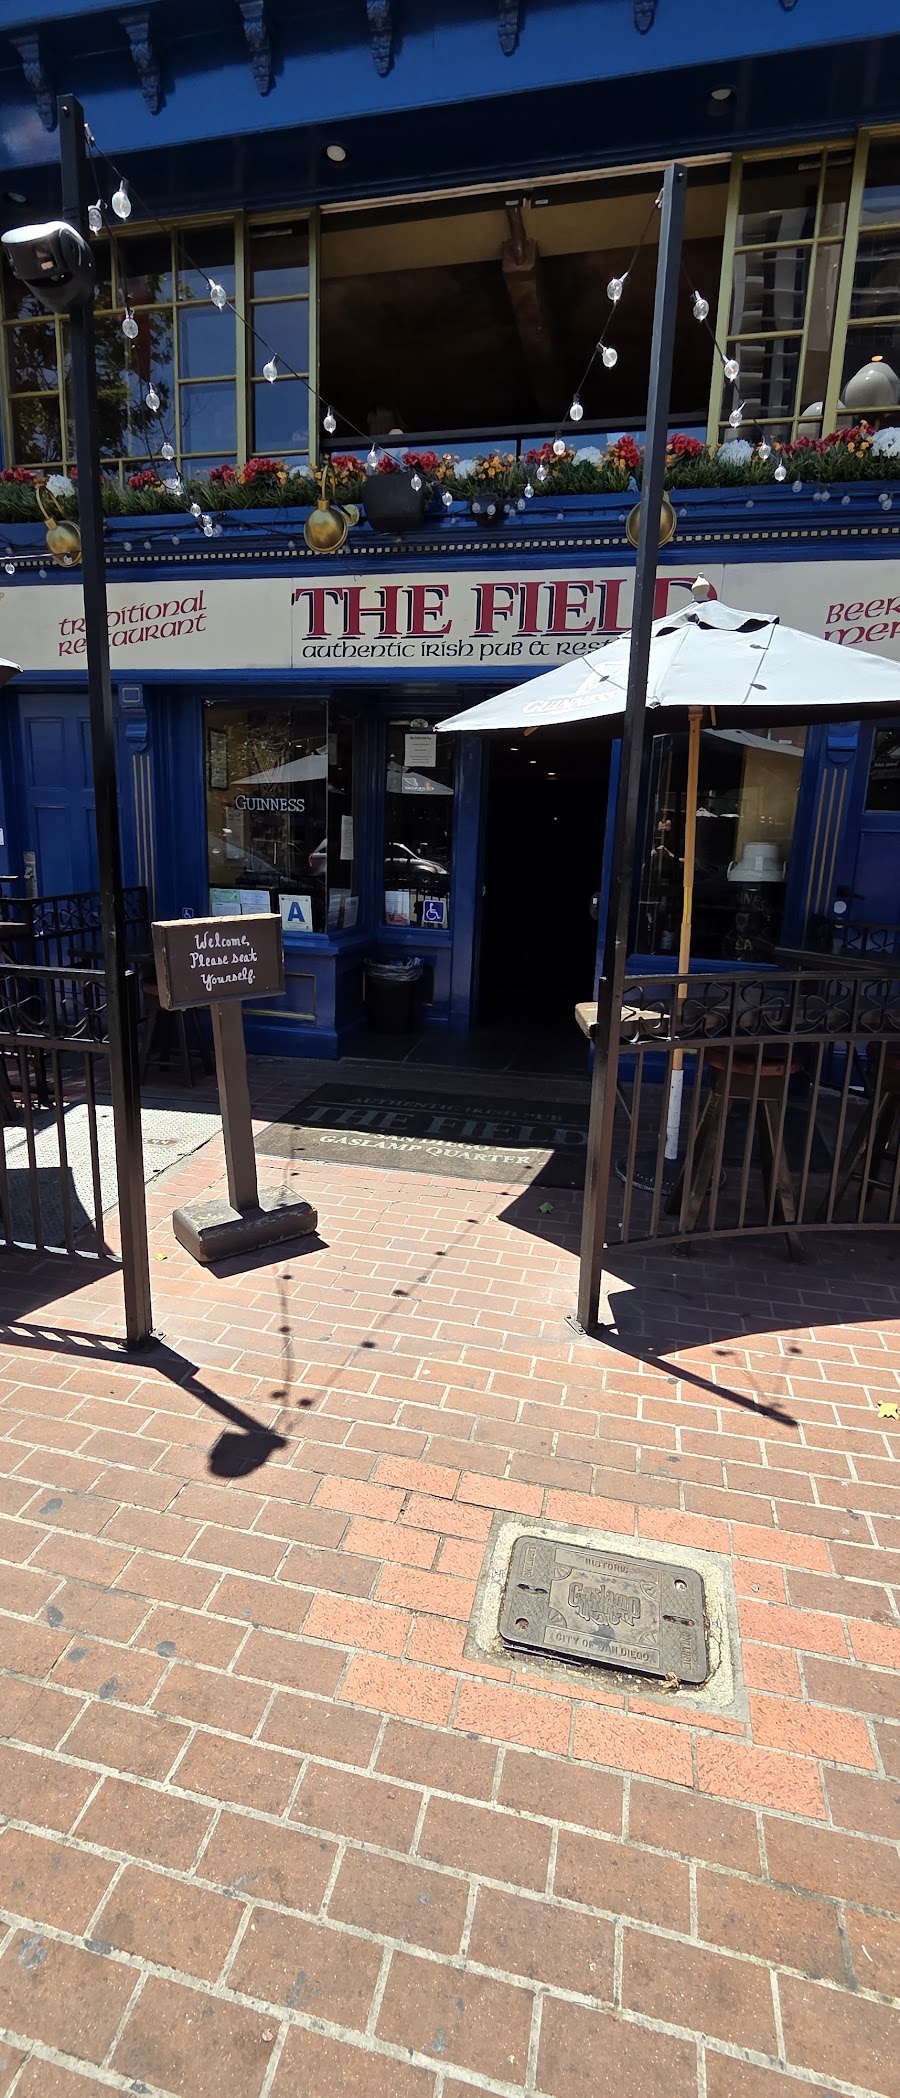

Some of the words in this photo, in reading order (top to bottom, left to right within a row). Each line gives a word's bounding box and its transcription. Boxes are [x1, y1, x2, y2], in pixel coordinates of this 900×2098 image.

[58, 590, 207, 636] trditional
[291, 584, 453, 640] THE
[302, 641, 416, 658] authentic
[421, 640, 474, 657] irish
[235, 794, 306, 812] GUINNESS
[287, 901, 306, 922] A
[194, 931, 250, 950] Welcome,
[189, 951, 229, 969] Please
[231, 948, 258, 964] seat
[303, 1105, 415, 1129] THE
[425, 1115, 588, 1146] FIELD
[374, 1132, 416, 1143] SAN
[319, 1134, 423, 1152] GASLAMP
[425, 1146, 532, 1165] QUARTER
[585, 1557, 629, 1574] HISTORIC
[555, 1632, 580, 1645] CITY
[582, 1639, 595, 1649] OF
[598, 1641, 618, 1654] SAN
[620, 1644, 651, 1663] DIEGO
